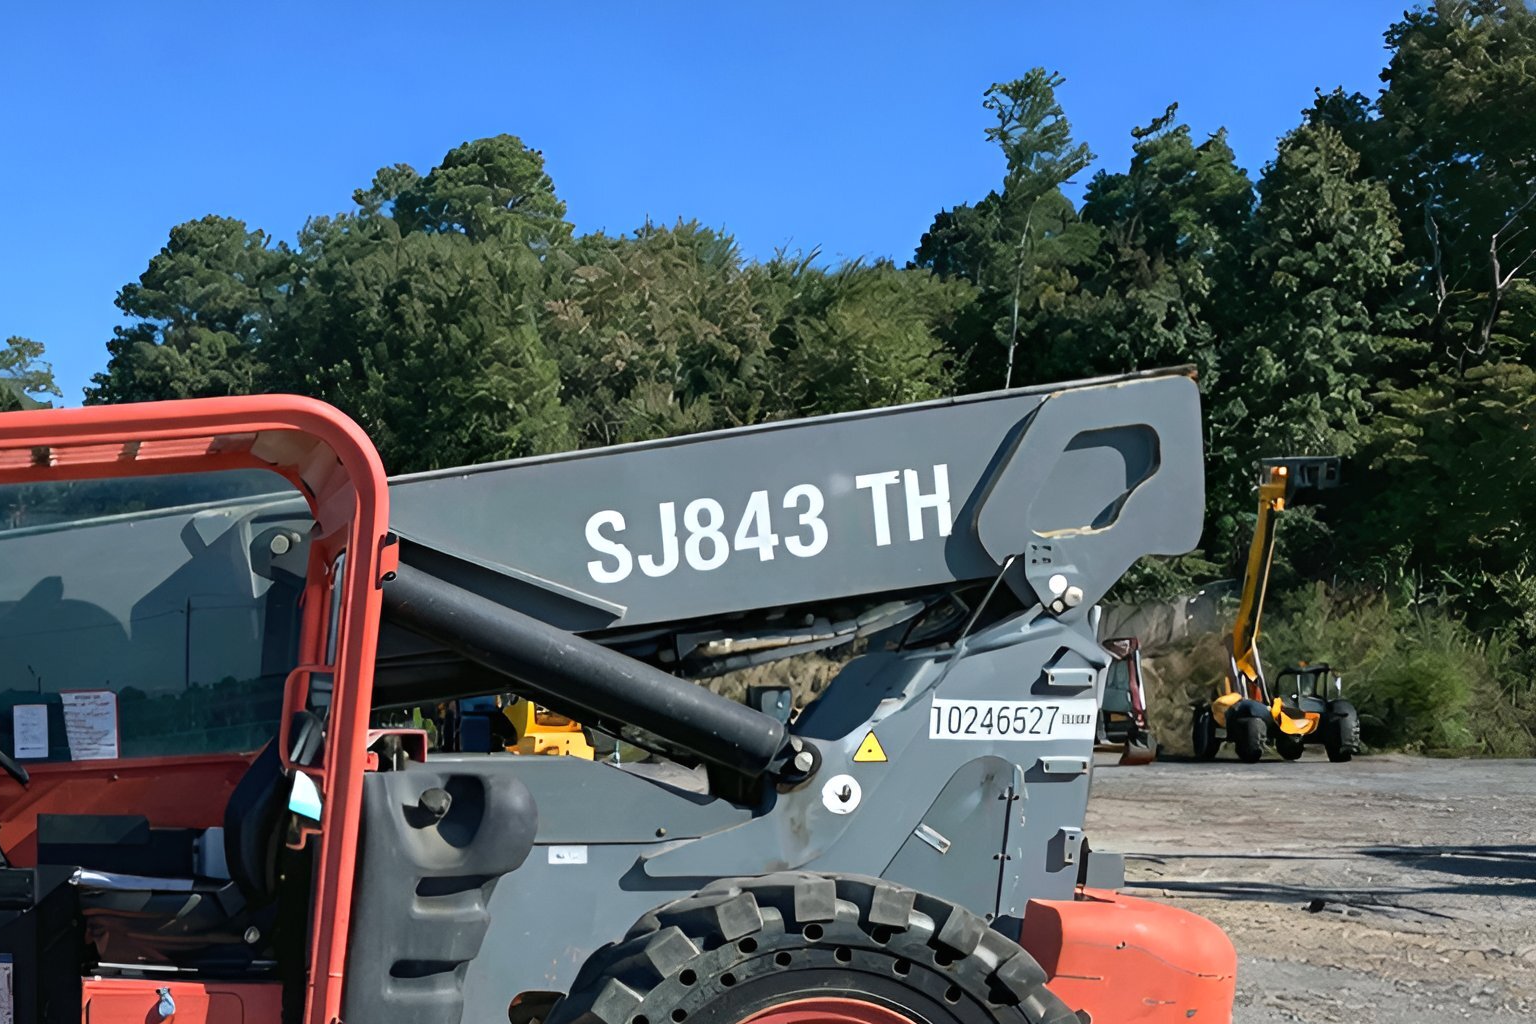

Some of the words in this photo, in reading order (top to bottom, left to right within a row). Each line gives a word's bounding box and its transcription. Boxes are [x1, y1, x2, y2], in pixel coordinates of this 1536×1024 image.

[584, 483, 829, 584] SJ843
[855, 463, 952, 547] TH
[932, 706, 1060, 735] 10246527
